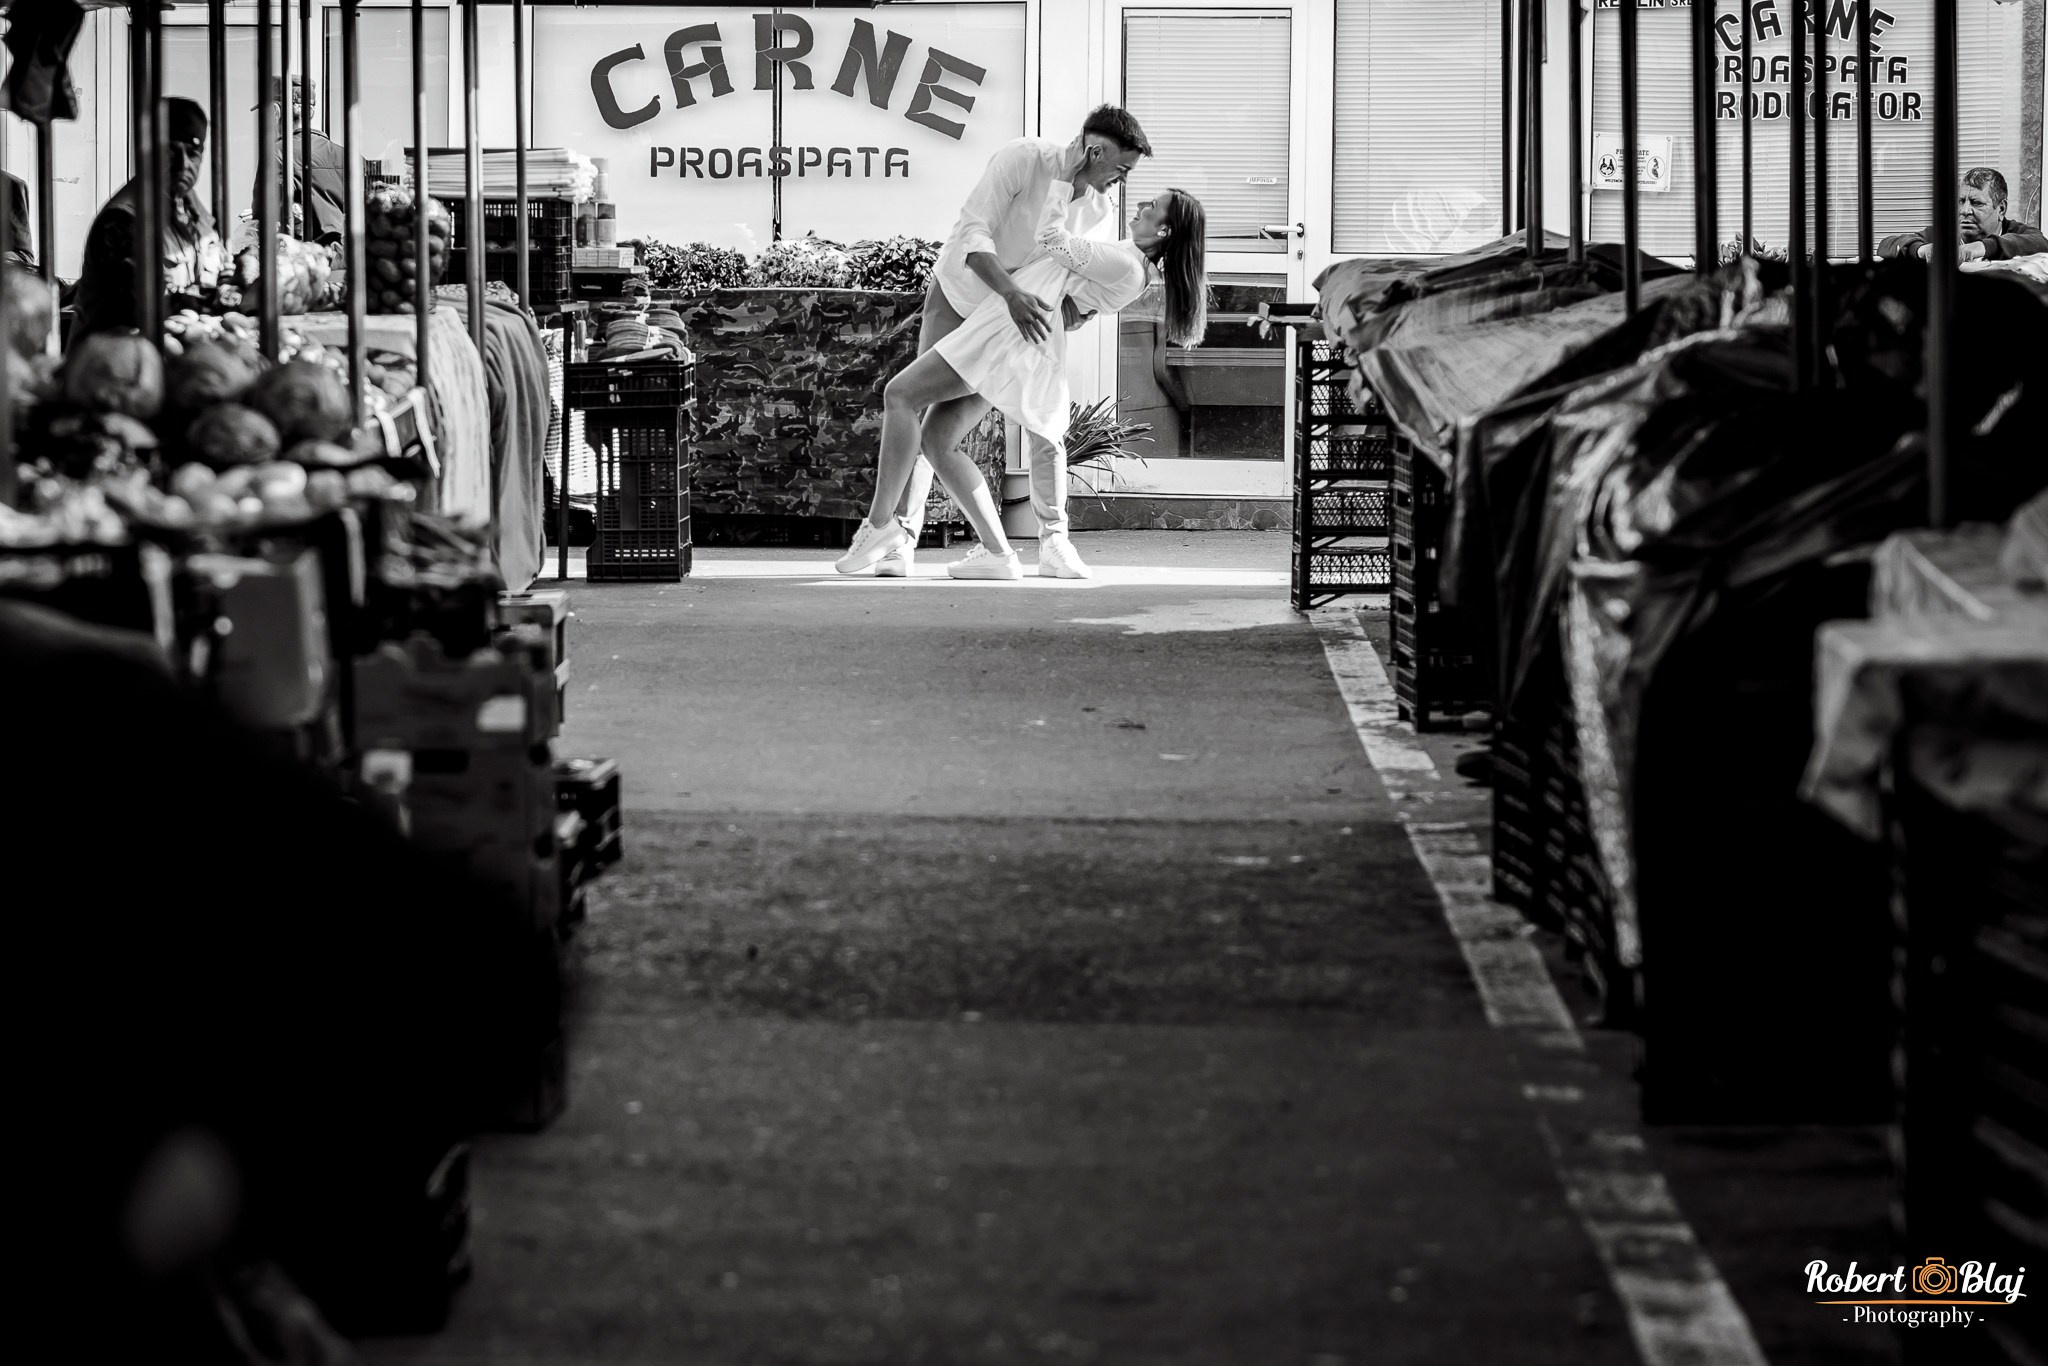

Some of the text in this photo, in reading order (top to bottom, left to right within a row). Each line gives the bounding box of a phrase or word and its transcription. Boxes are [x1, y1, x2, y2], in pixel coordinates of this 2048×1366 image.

[1598, 0, 1664, 8] RELIN
[590, 13, 987, 141] CARNE
[1715, 55, 1909, 84] ROASPATA
[1716, 92, 1922, 120] RODAOR
[650, 146, 909, 179] PROASPATA
